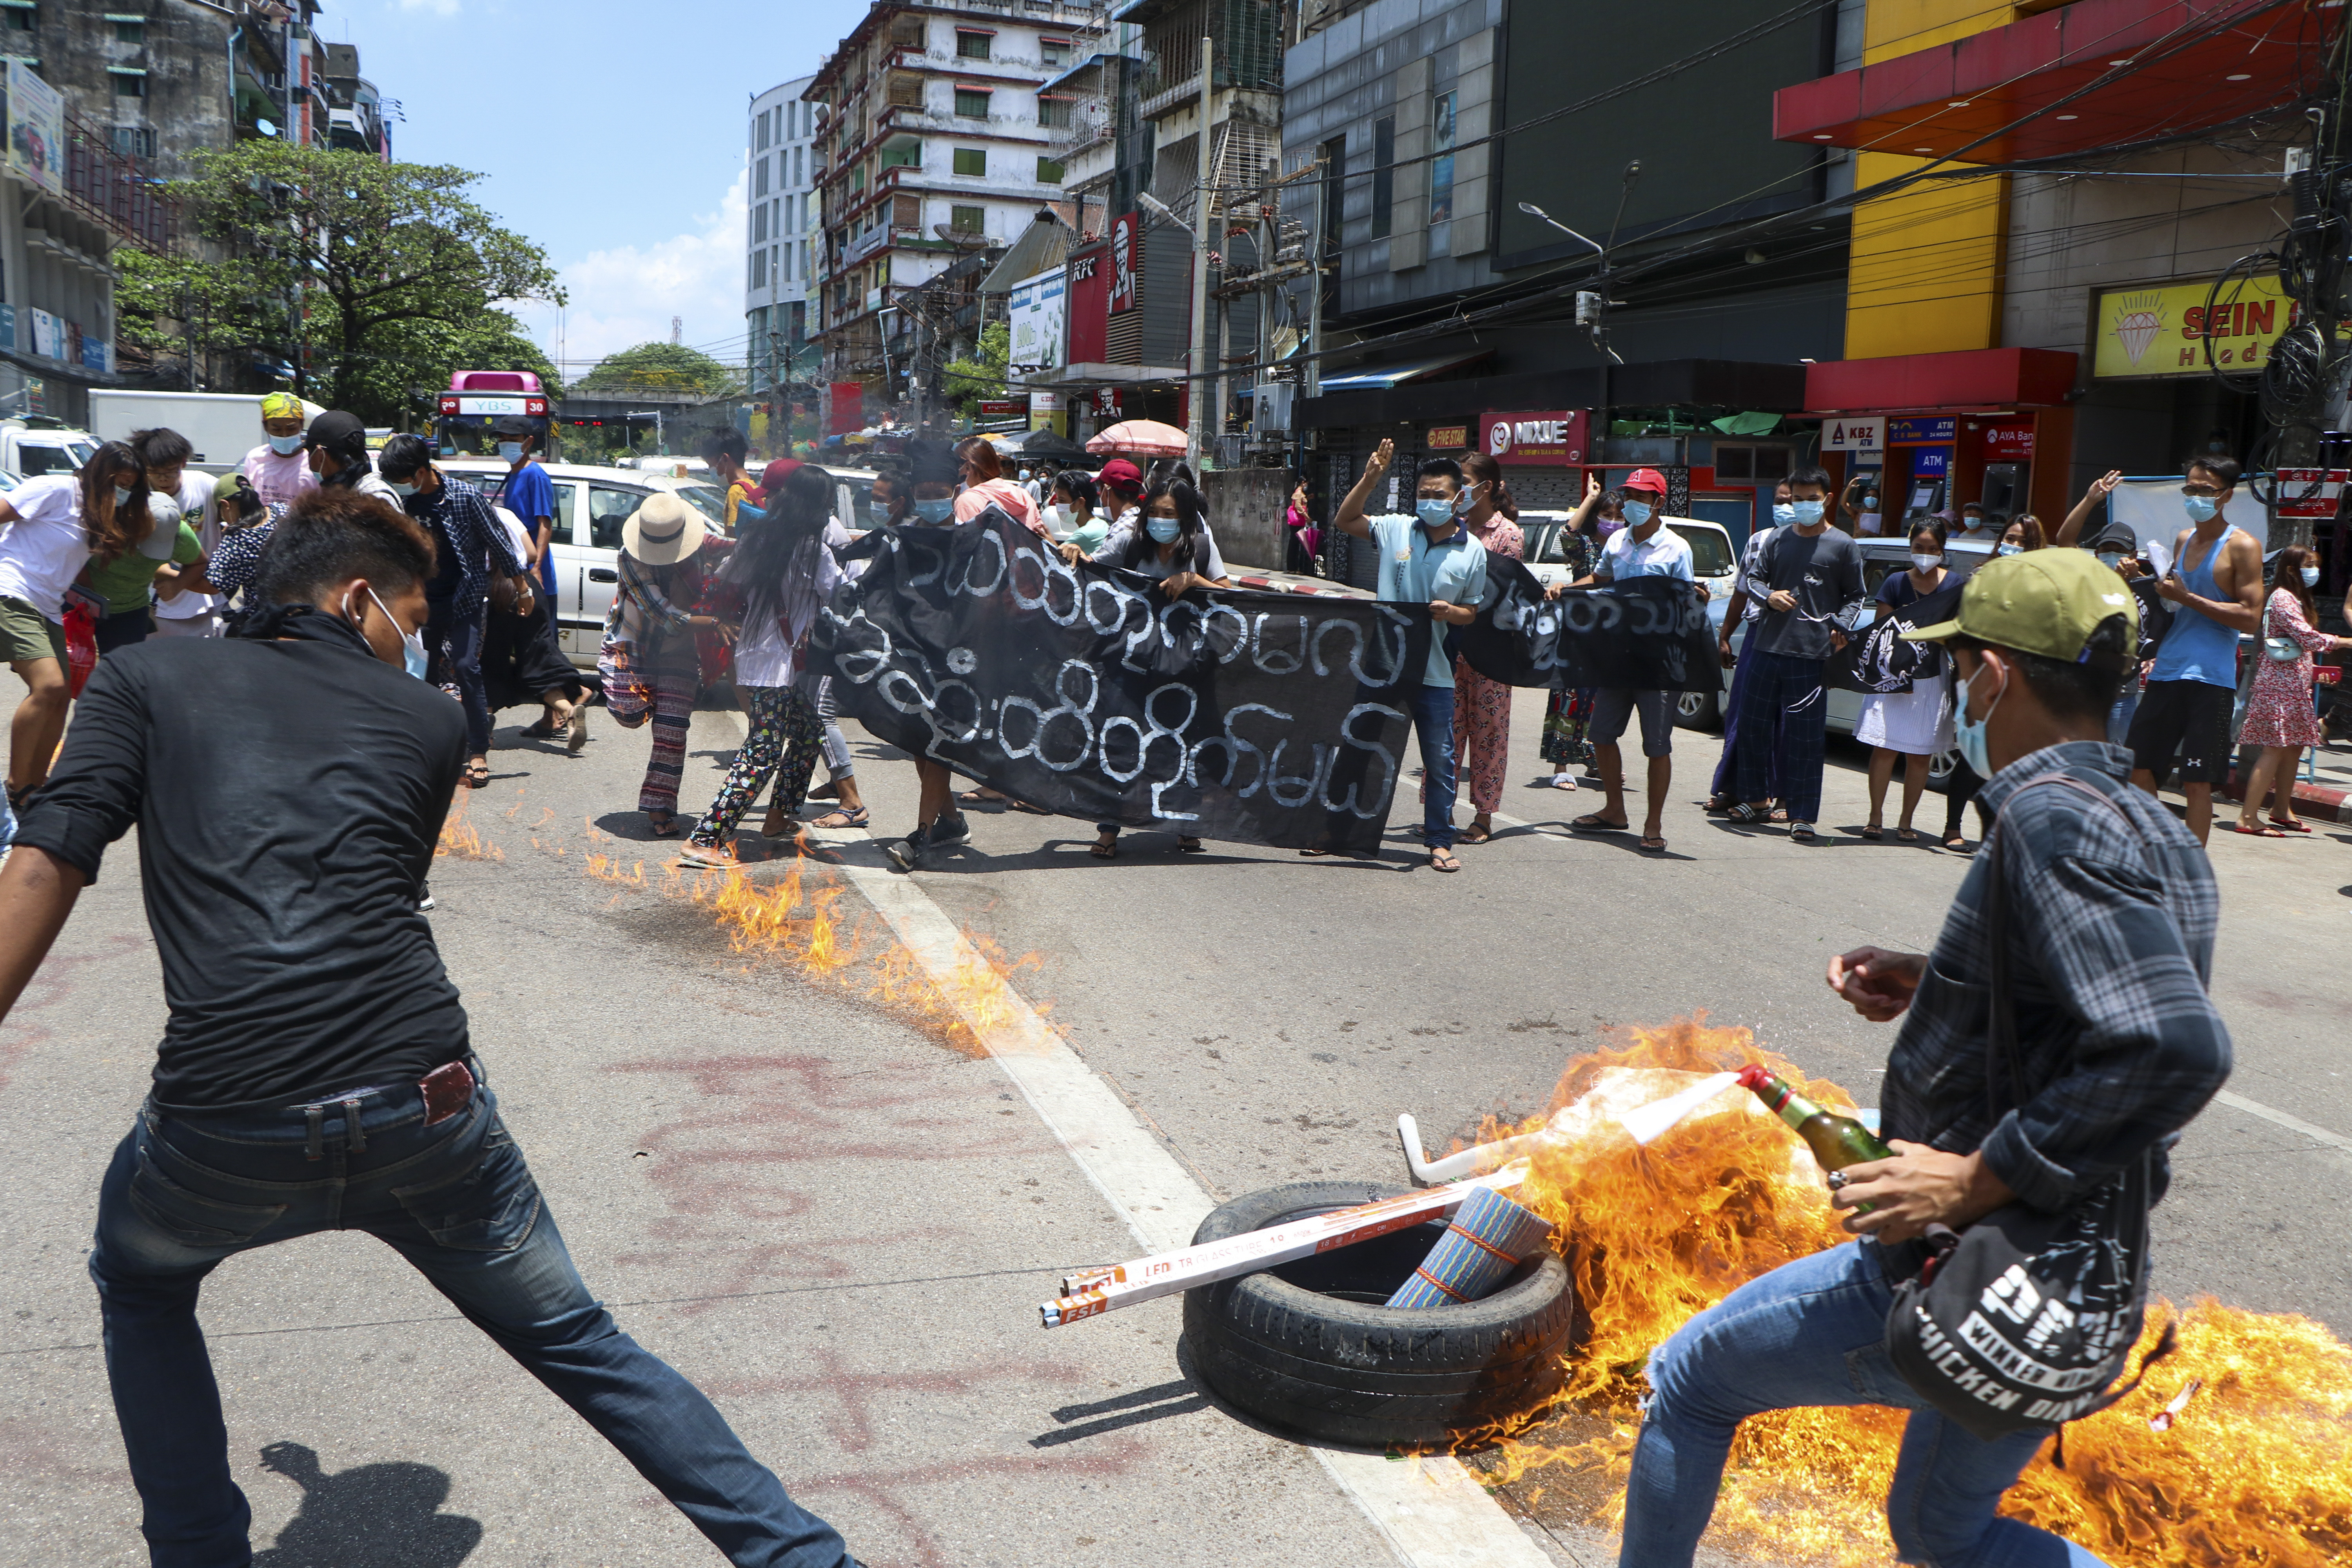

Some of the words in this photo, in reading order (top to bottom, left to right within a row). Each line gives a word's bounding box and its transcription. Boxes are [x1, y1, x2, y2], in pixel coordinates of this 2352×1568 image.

[1073, 257, 1095, 281] KFC
[2182, 300, 2275, 339] SEIN
[2179, 342, 2272, 366] Hed
[474, 401, 512, 410] YBS
[529, 403, 544, 412] 30
[1436, 430, 1450, 445] FIVE
[1450, 429, 1465, 445] STAR
[1514, 421, 1568, 444] MIXUE
[1850, 427, 1873, 439] KBZ
[1999, 432, 2015, 440] AYA
[2018, 431, 2033, 440] Ban
[1859, 438, 1873, 446] ATM
[1923, 456, 1942, 466] ATM
[1146, 1262, 1170, 1277] LED
[1060, 1292, 1102, 1308] FSL
[1065, 1303, 1100, 1322] FSL
